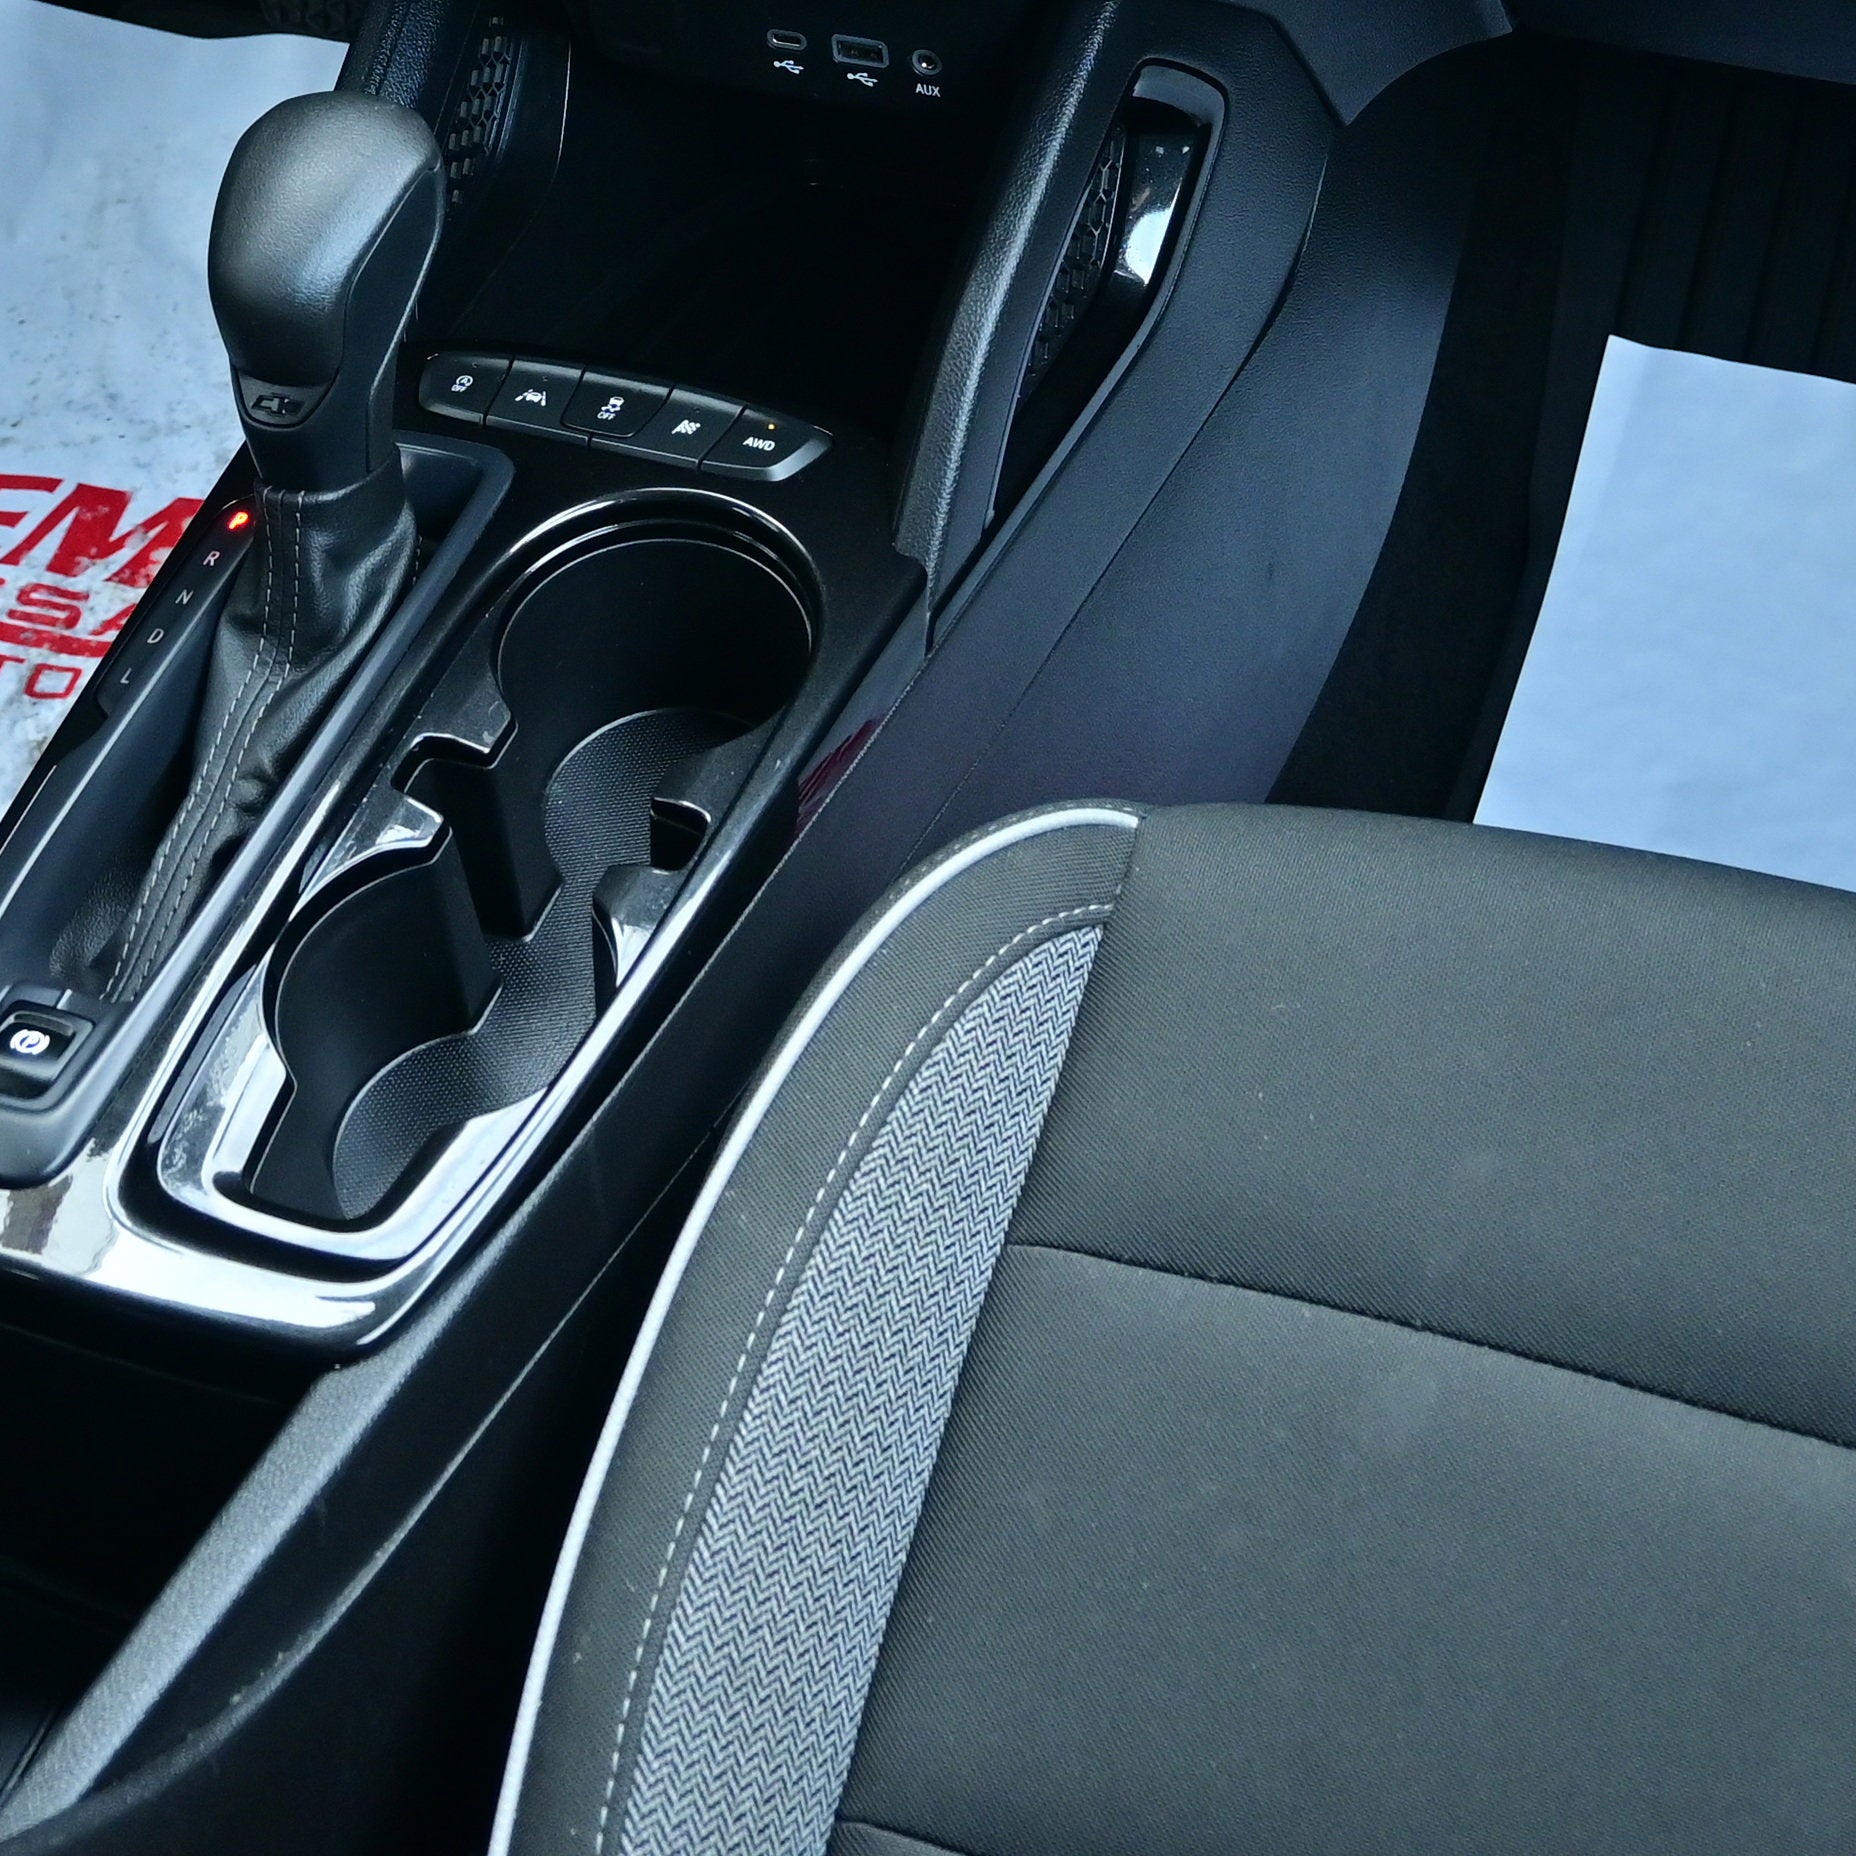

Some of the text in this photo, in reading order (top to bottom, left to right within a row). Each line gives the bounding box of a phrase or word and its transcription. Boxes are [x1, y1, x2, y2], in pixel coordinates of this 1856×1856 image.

[915, 83, 941, 97] AUX
[742, 436, 776, 451] AWD
[228, 511, 249, 531] P
[203, 550, 220, 566] R
[175, 589, 194, 605] N
[147, 628, 164, 644] D
[120, 668, 132, 684] L
